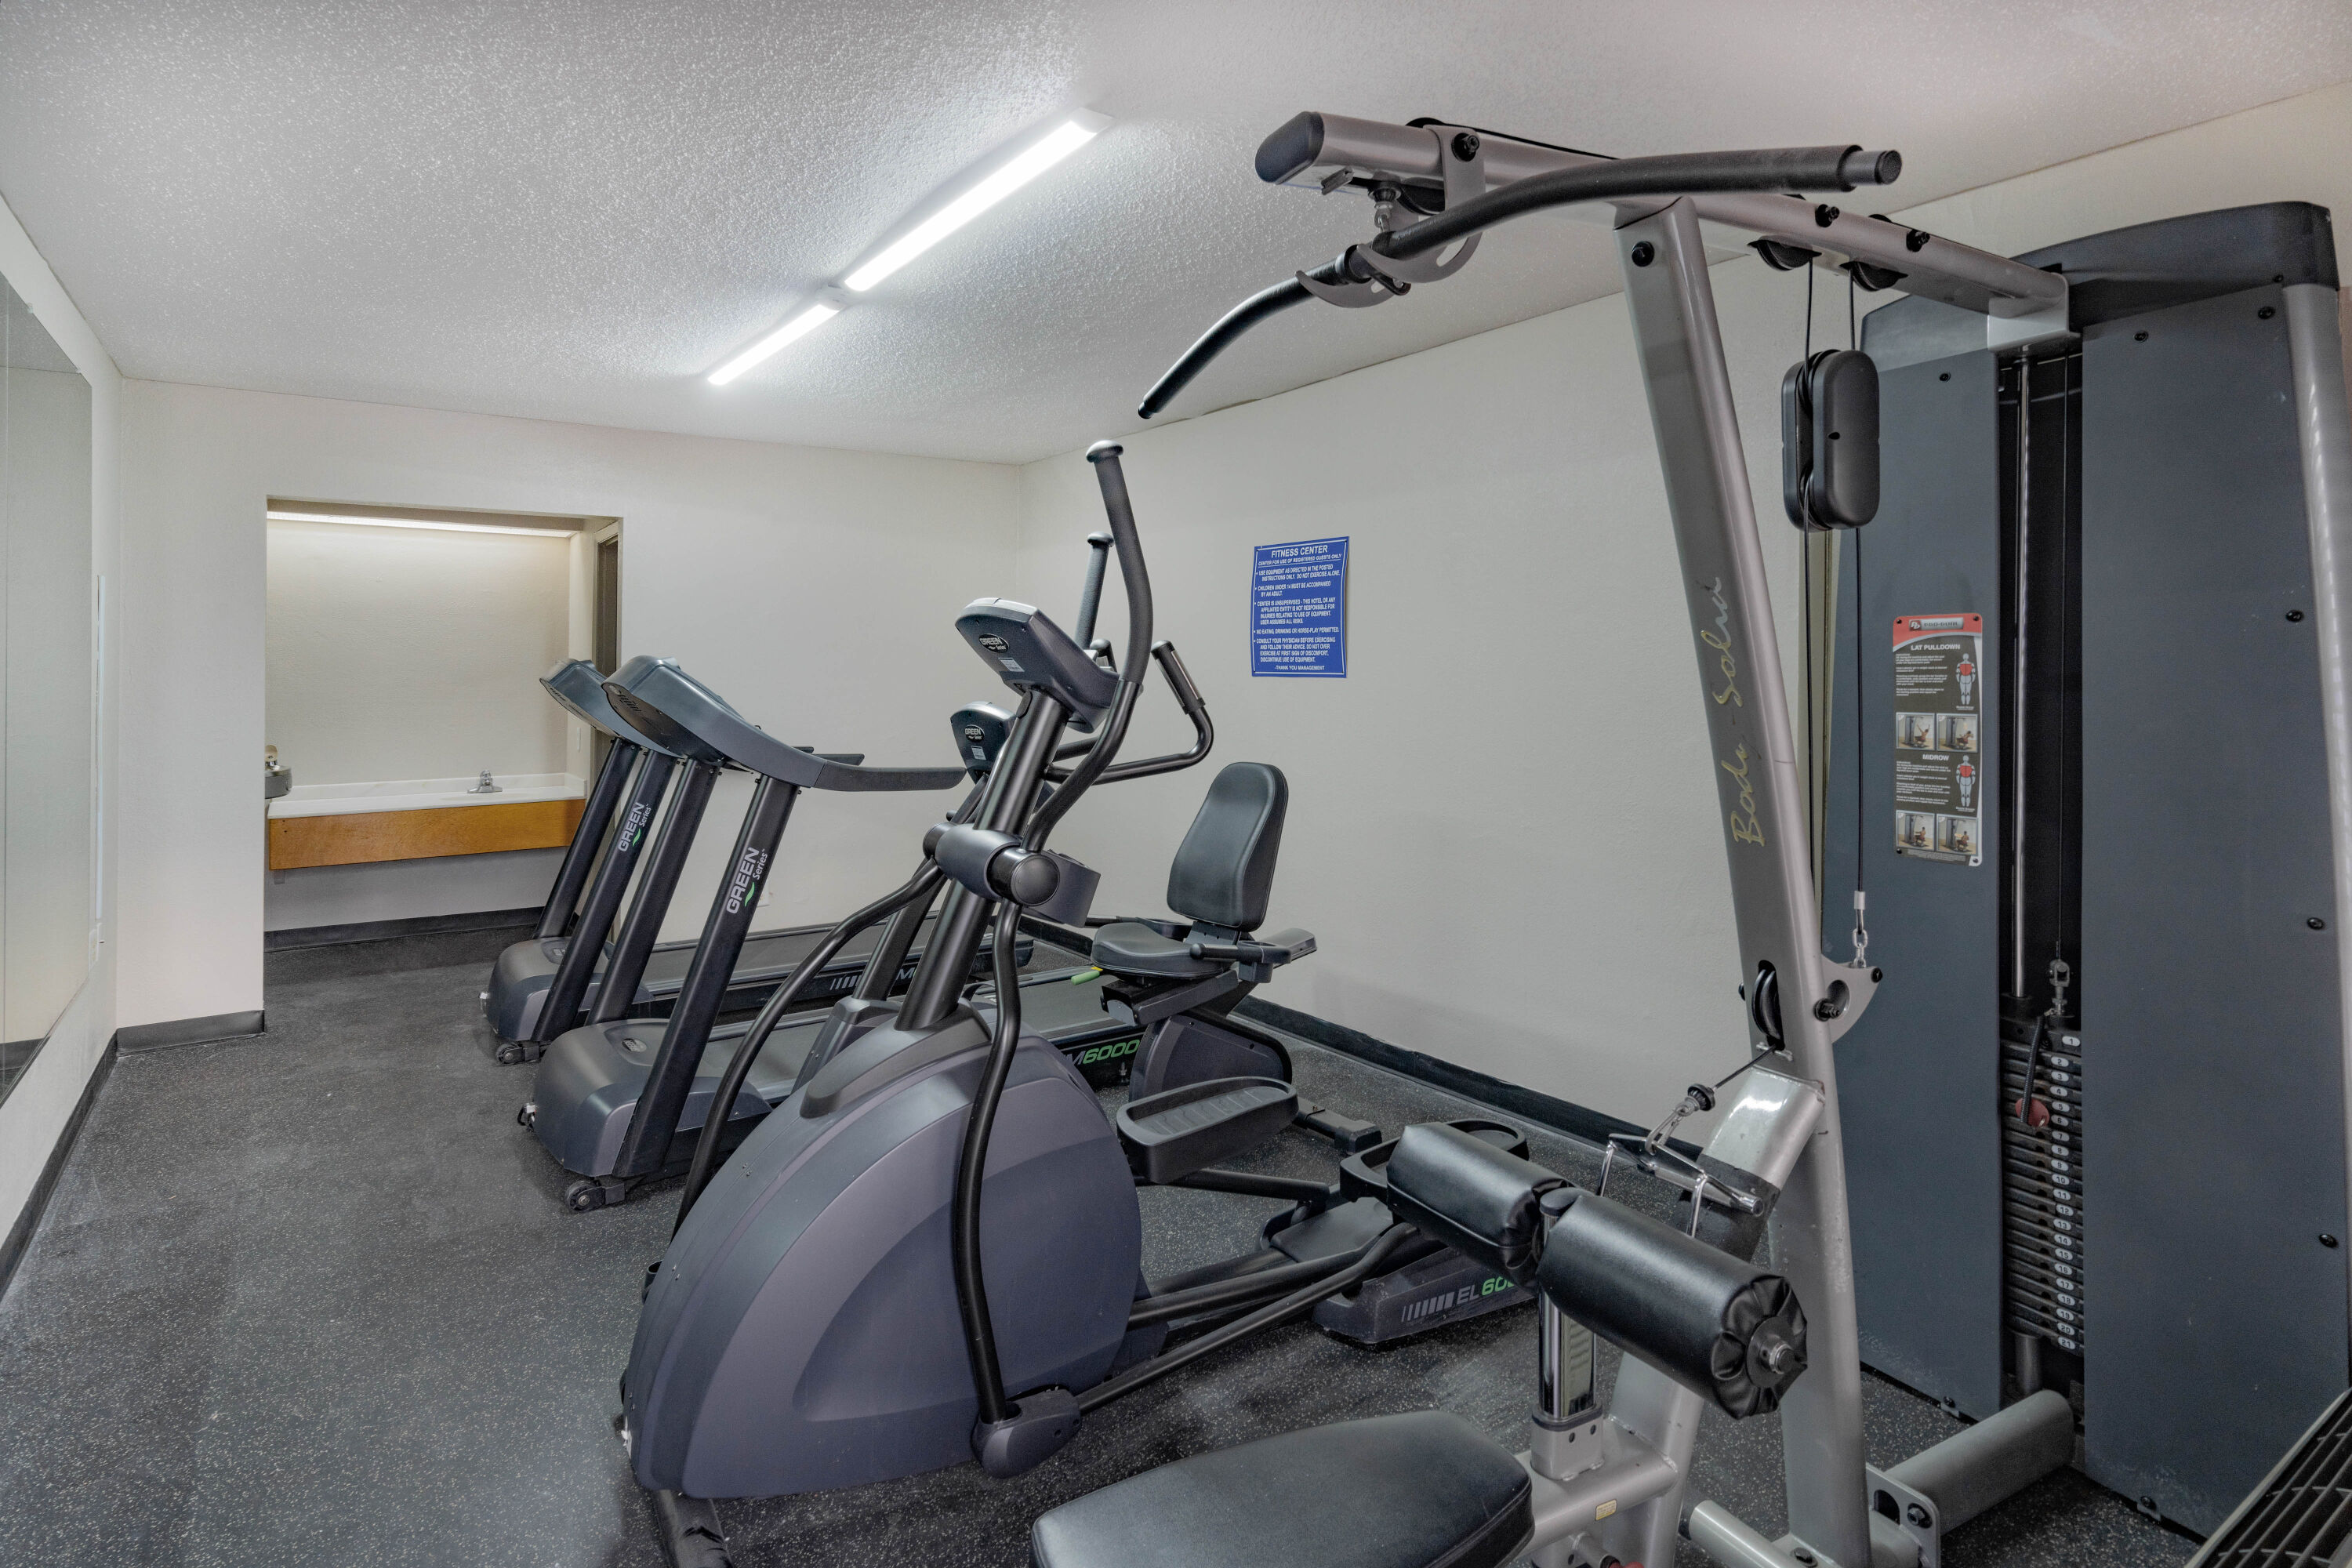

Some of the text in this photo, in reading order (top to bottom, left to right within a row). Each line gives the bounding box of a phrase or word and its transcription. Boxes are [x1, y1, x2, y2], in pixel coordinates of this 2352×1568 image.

[1271, 545, 1328, 558] FITNESS CENTER
[979, 637, 1003, 645] GREEN
[639, 807, 652, 827] Series
[618, 802, 644, 852] GREEN
[752, 852, 768, 880] Series
[726, 847, 760, 914] GREEN
[1061, 1039, 1141, 1065] M6000
[2058, 1191, 2067, 1200] 11
[2058, 1221, 2067, 1229] 13
[2058, 1236, 2067, 1244] 14
[2060, 1250, 2069, 1259] 15
[2059, 1265, 2068, 1274] 16
[2060, 1280, 2070, 1289] 17
[2061, 1296, 2071, 1305] 18
[2060, 1311, 2070, 1319] 19
[2061, 1325, 2071, 1334] 20
[2062, 1339, 2071, 1348] 21
